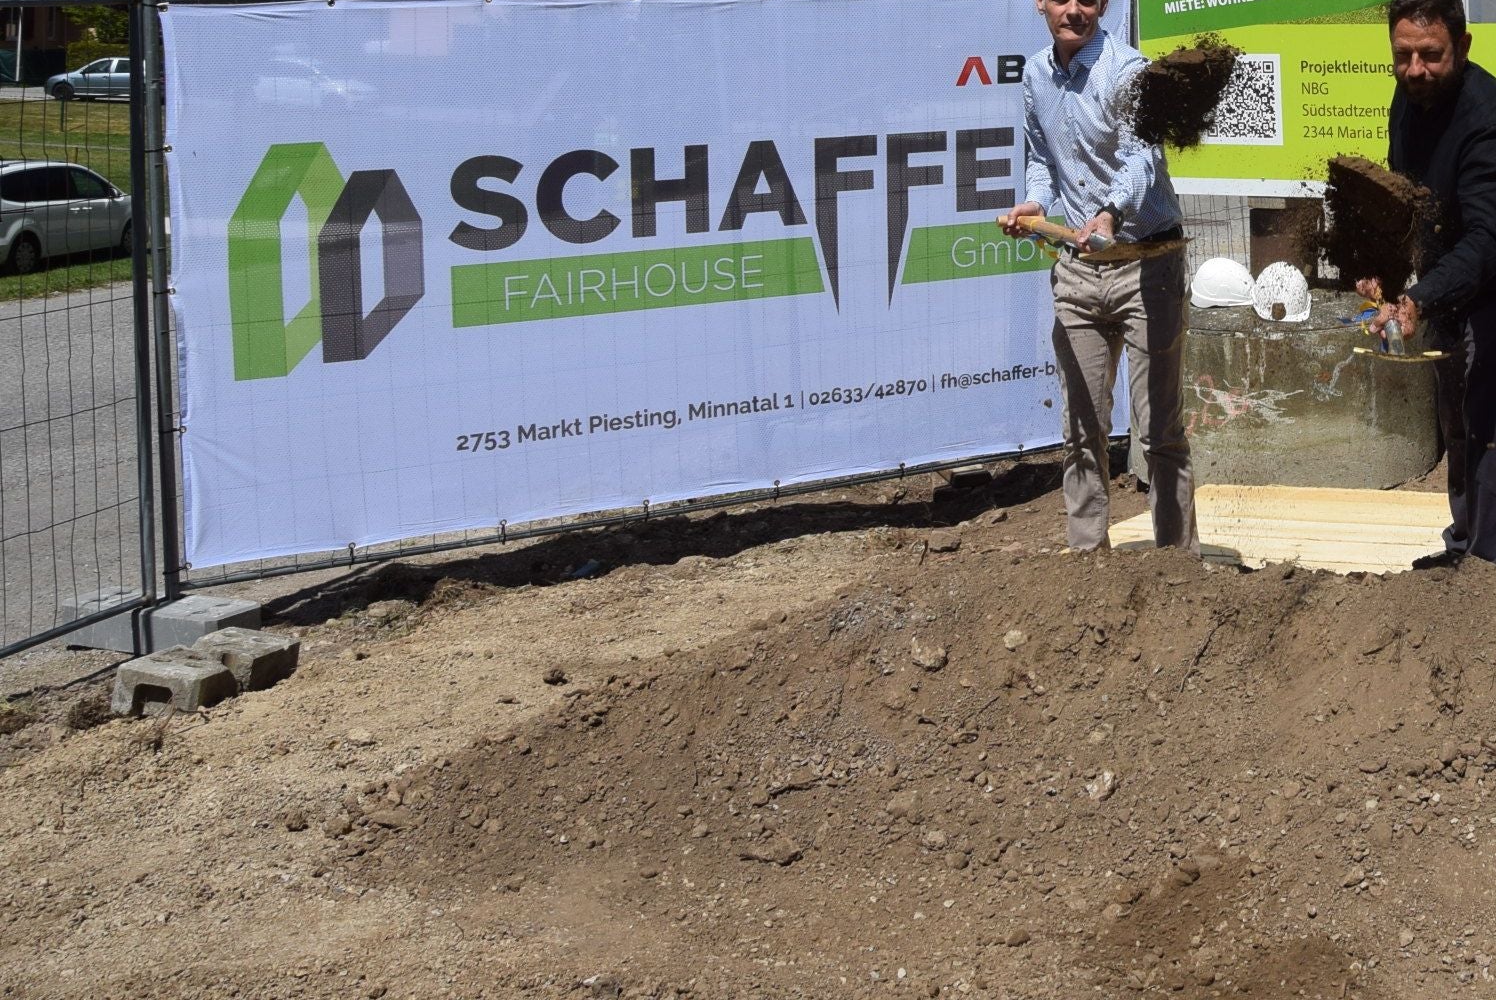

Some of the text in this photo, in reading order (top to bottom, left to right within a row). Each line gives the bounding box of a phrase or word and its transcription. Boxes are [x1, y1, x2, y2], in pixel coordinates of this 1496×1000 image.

[956, 55, 1026, 86] AB
[1300, 60, 1394, 76] Projektleitung
[1301, 82, 1328, 94] NBG
[1302, 104, 1390, 117] Südstadtzentr
[1303, 126, 1333, 138] 2344
[1338, 127, 1372, 138] Maria
[448, 127, 1015, 315] SCHAFFE
[502, 254, 764, 311] FAIRHOUSE
[456, 361, 1058, 452] 2753 Markt Piesting, Minnatal 1 02633/42870 fh@schaffer-b
